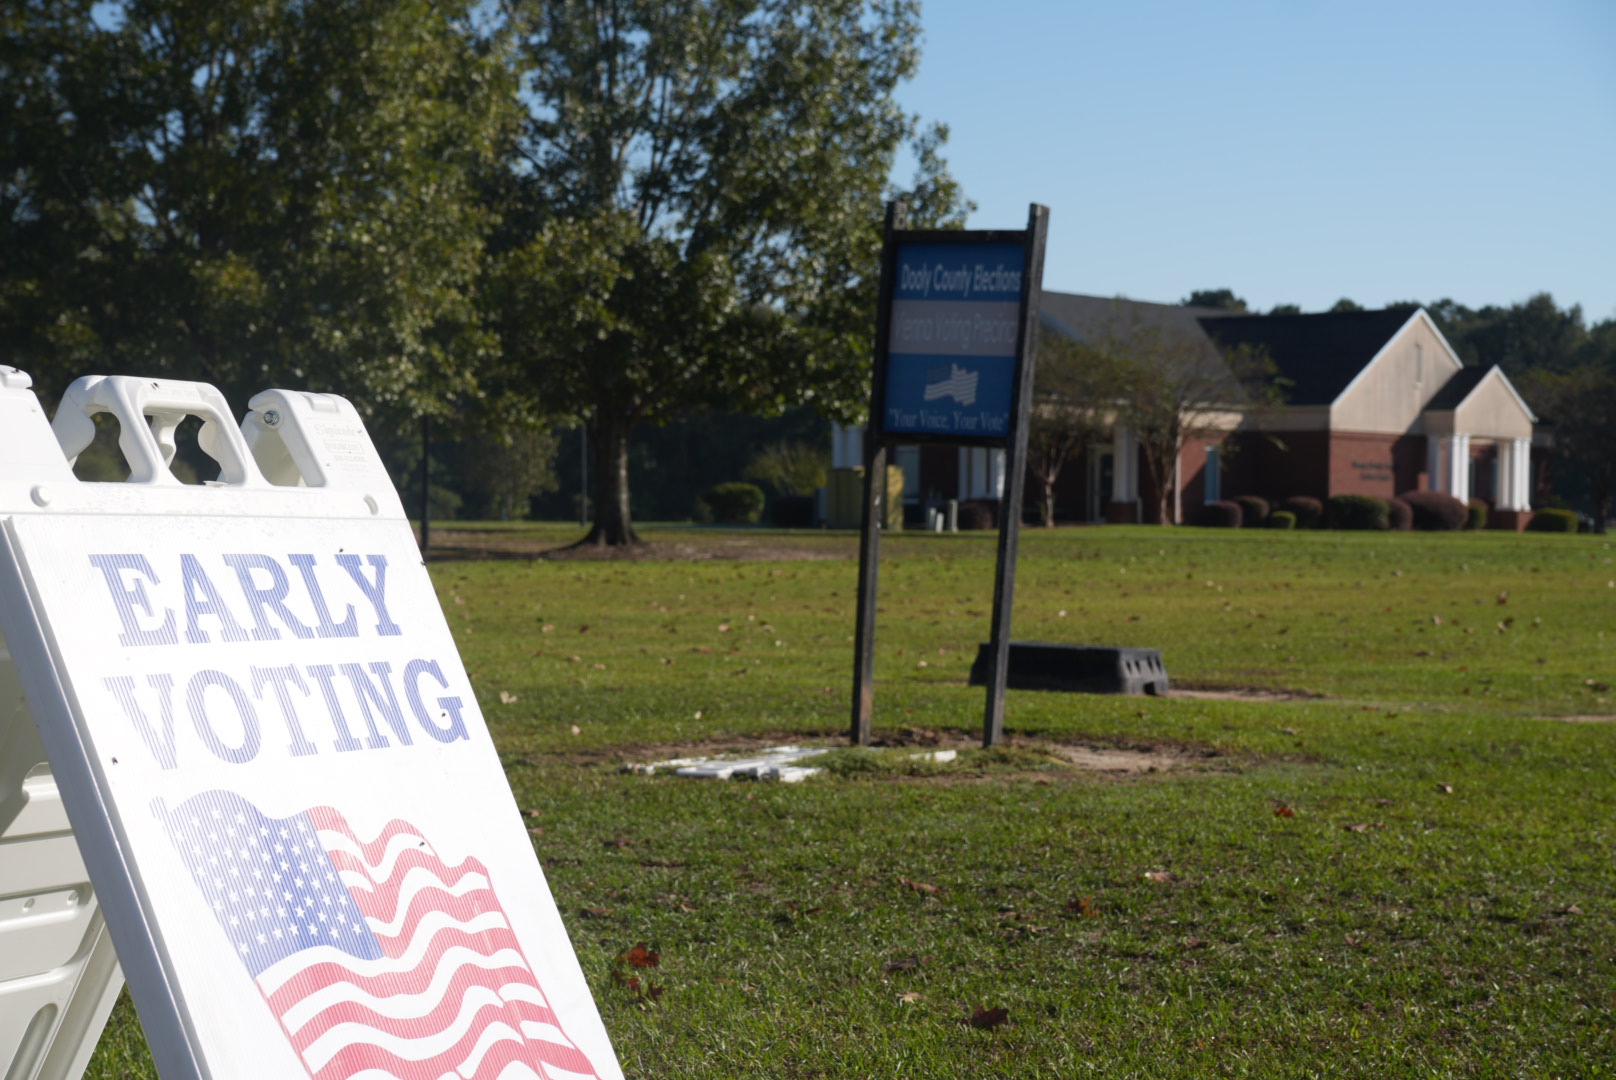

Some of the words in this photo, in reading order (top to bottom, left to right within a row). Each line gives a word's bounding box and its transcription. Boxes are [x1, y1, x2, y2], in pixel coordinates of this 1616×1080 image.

[901, 262, 932, 297] Dooly
[933, 263, 973, 297] County
[973, 263, 1021, 292] Elections
[935, 312, 971, 350] Voting
[953, 410, 978, 430] Your
[88, 553, 402, 647] EARLY
[101, 658, 471, 770] VOTING
